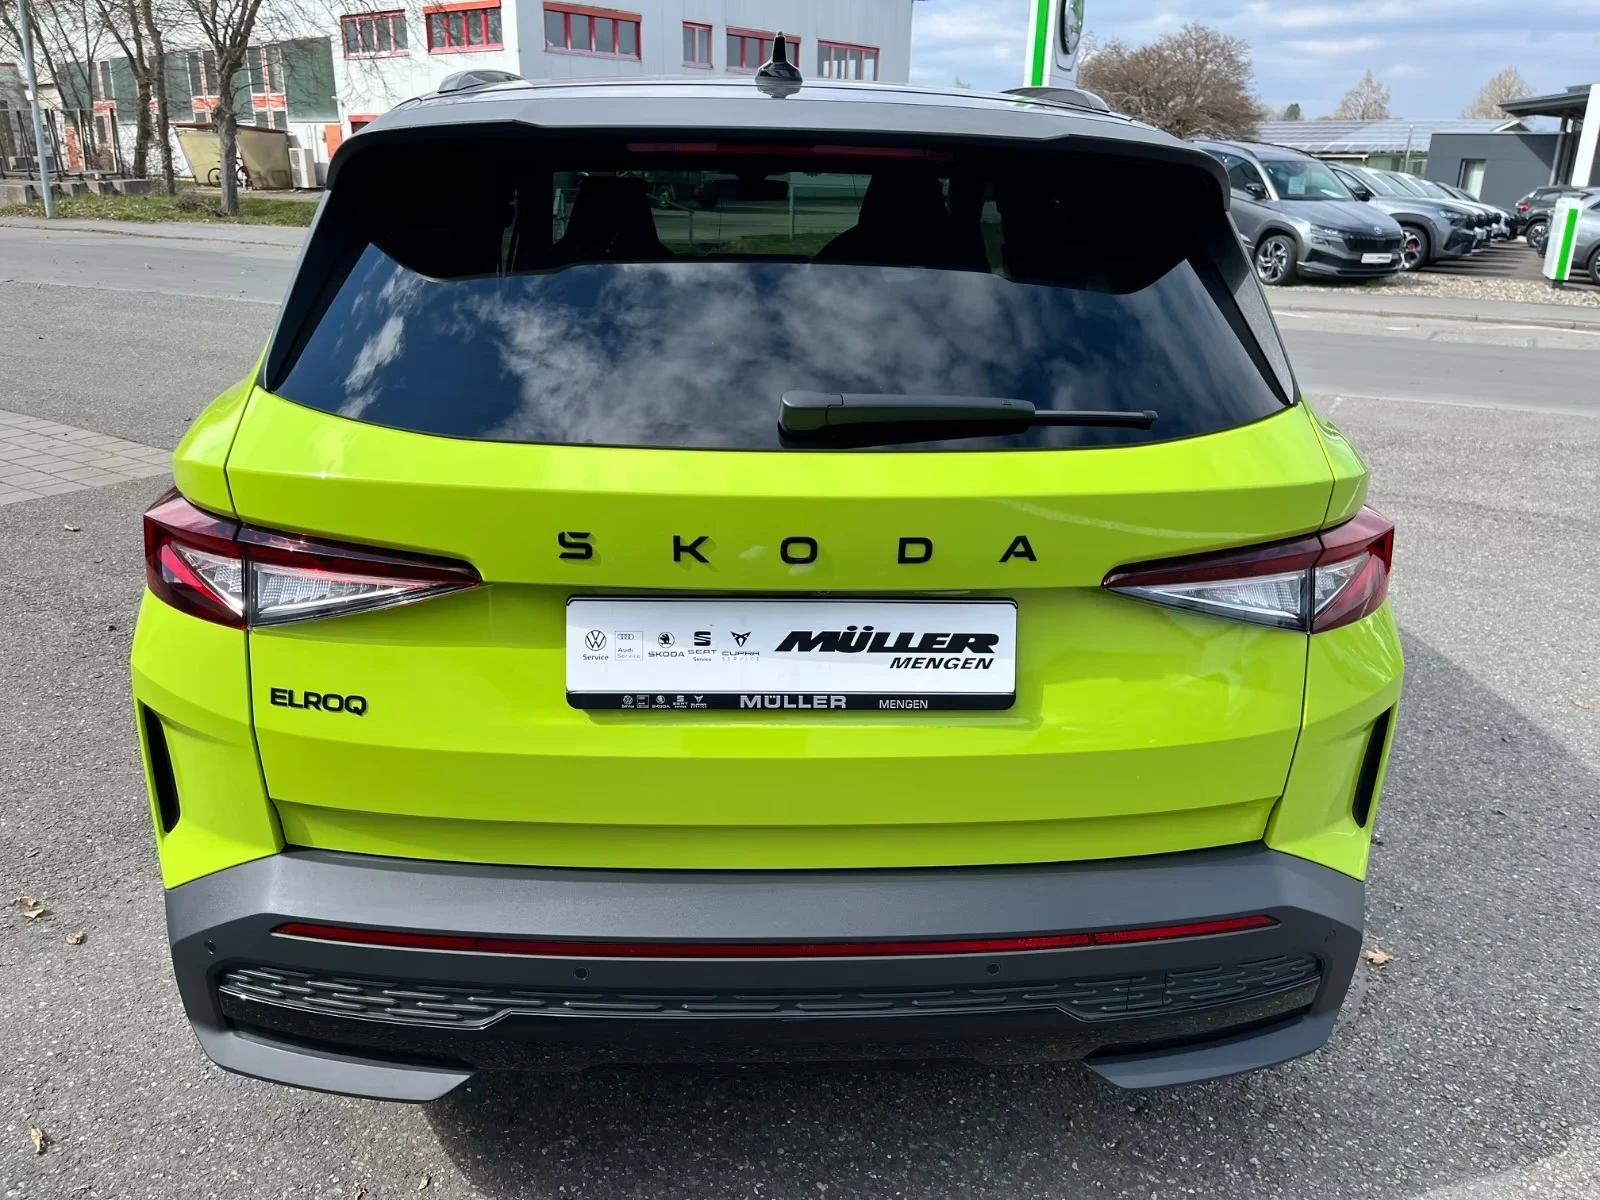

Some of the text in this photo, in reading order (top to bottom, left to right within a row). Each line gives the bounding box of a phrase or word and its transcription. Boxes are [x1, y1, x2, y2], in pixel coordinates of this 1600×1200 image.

[774, 625, 999, 653] MÜLLER
[889, 657, 994, 670] MENGEN
[270, 687, 367, 717] ELROQ
[739, 695, 847, 709] MÜLLER
[879, 700, 929, 709] MENGEN
